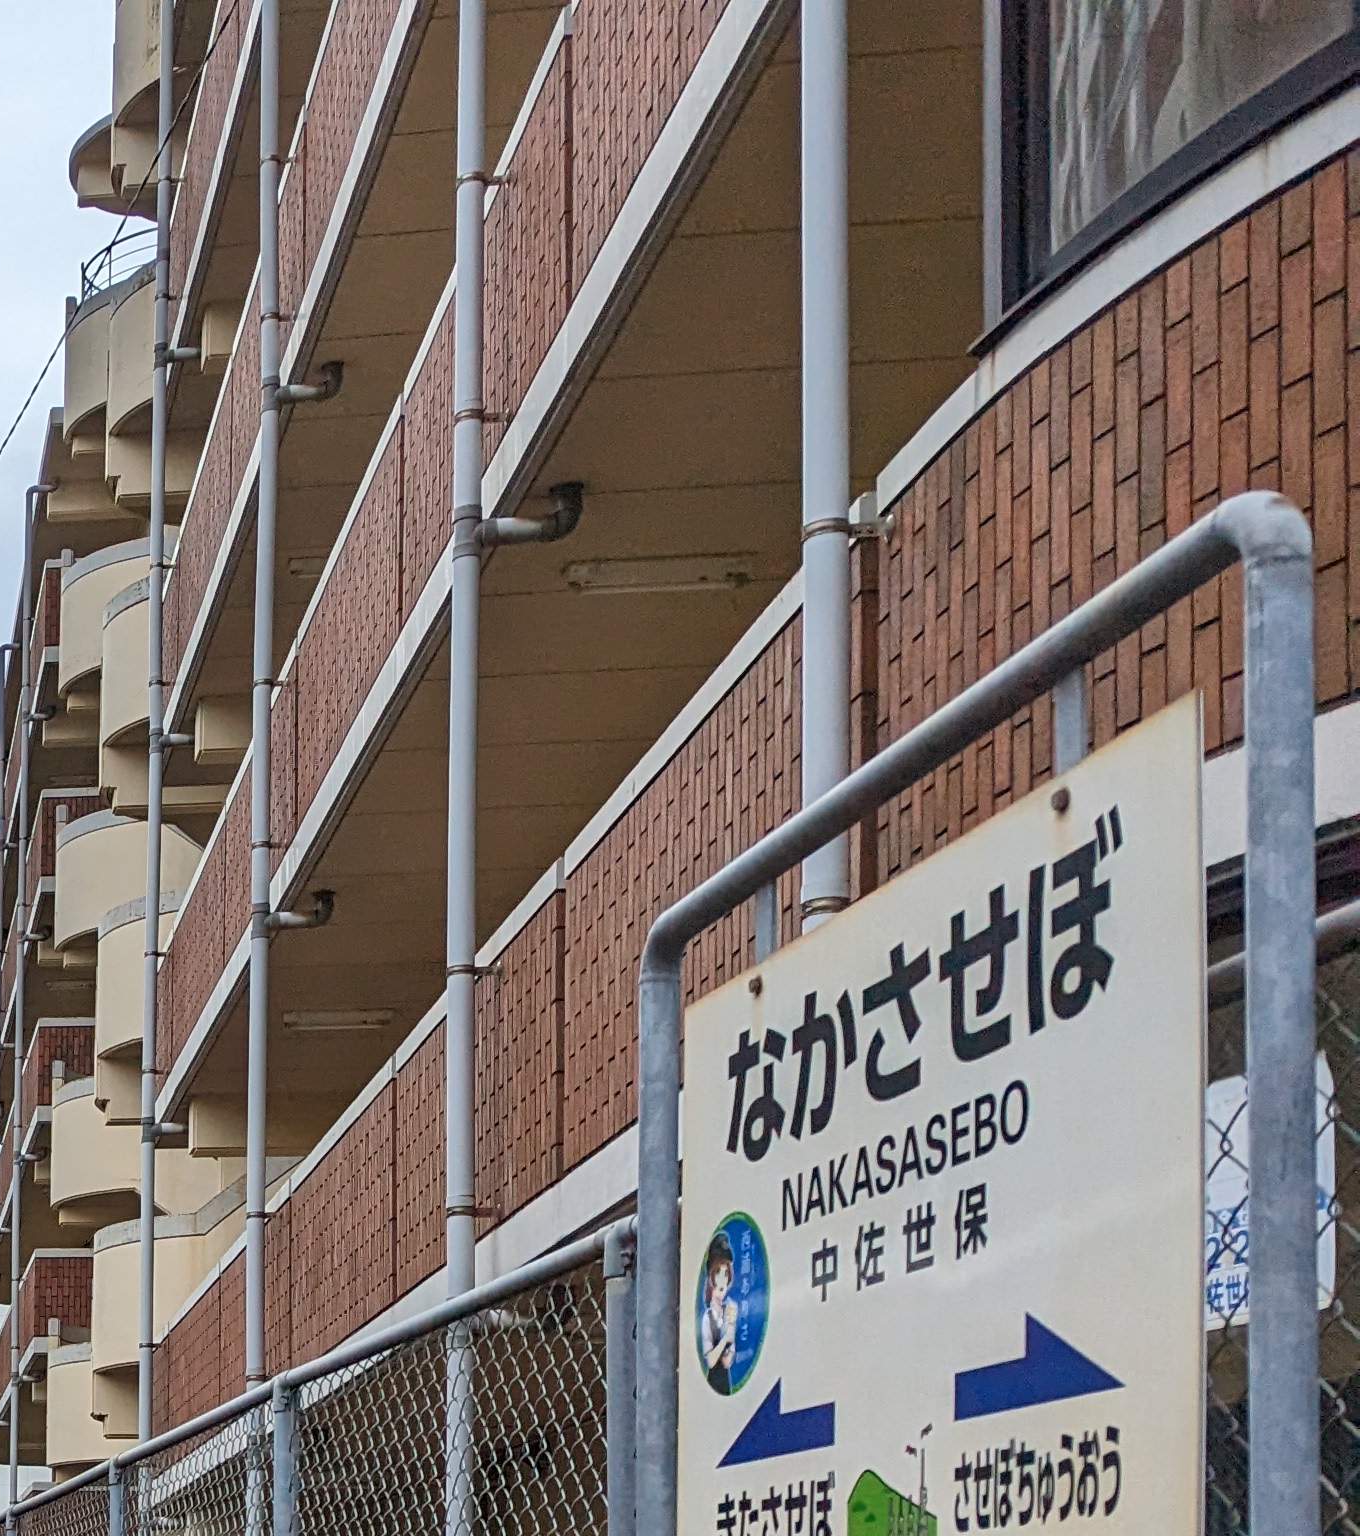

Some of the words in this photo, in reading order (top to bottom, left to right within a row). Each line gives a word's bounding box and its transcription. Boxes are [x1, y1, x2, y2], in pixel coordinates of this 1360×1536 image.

[726, 804, 1123, 1162] なかさせぼ
[781, 1080, 1029, 1231] NAKASASEBO
[811, 1183, 988, 1302] 中佐世保
[954, 1426, 1121, 1533] させぼちゅうおう
